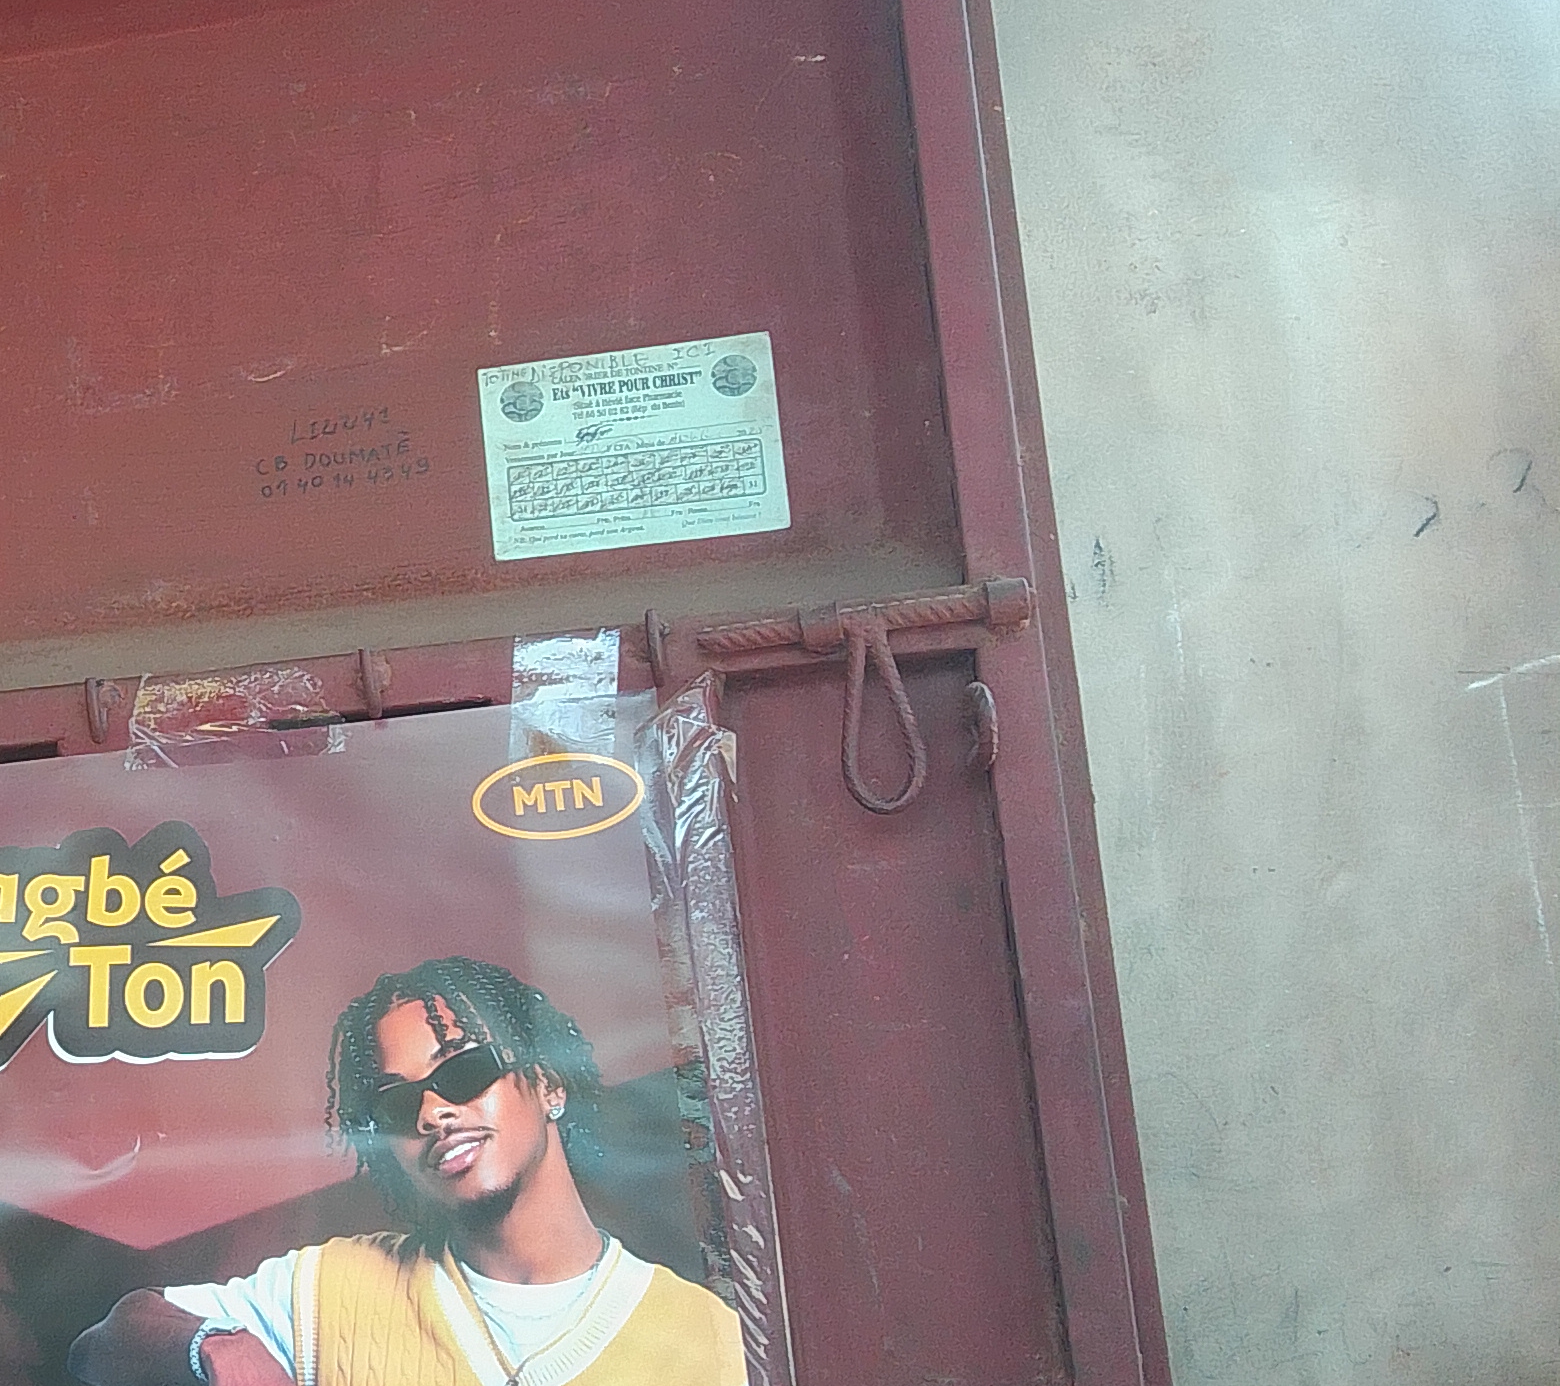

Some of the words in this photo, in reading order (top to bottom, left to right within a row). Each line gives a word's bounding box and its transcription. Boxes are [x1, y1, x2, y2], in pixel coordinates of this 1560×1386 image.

[672, 342, 716, 361] ICI
[624, 364, 664, 377] TONTINE
[551, 387, 571, 402] Ets
[618, 375, 651, 393] POUR
[512, 776, 604, 816] MTN
[68, 944, 246, 1028] Ton
